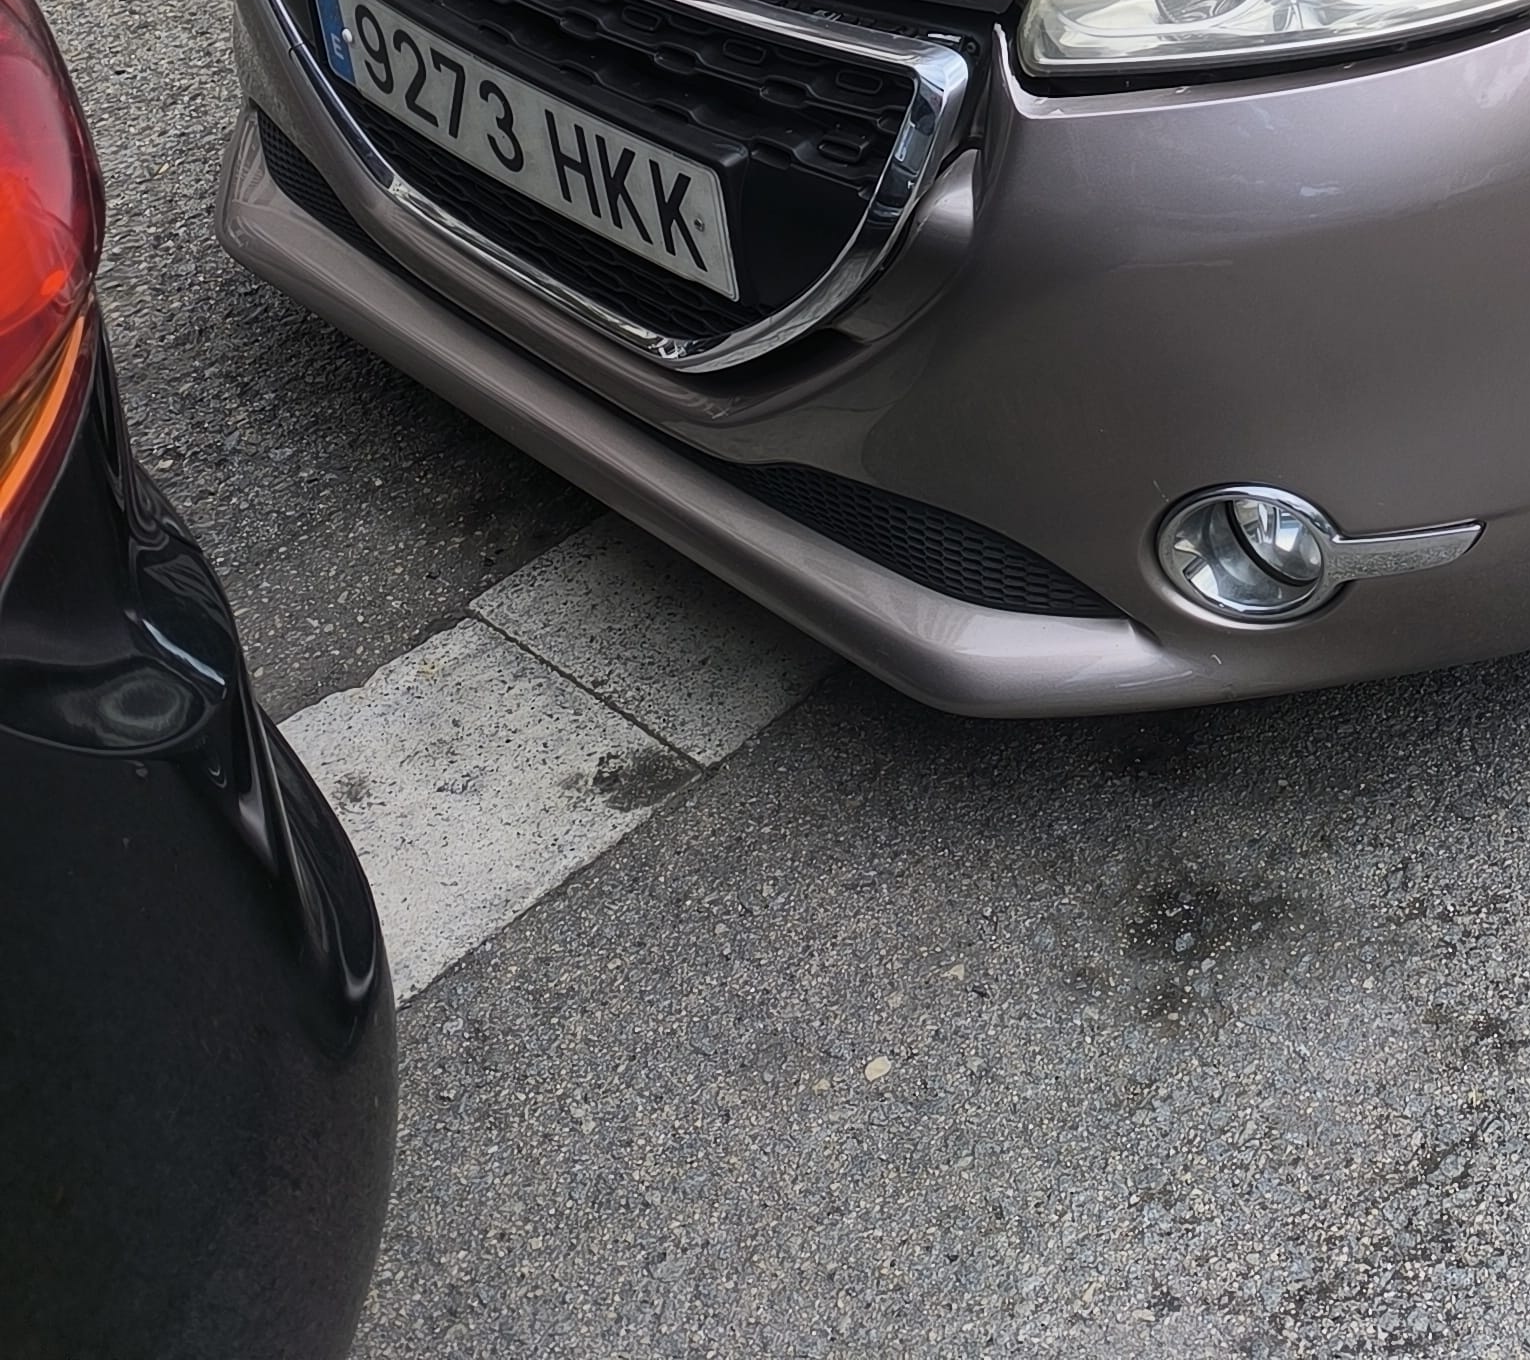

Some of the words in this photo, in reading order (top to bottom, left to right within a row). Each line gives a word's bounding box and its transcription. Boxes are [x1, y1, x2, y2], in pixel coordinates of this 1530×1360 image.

[331, 32, 345, 61] E
[353, 3, 524, 172] 9273
[544, 108, 709, 273] HKK
